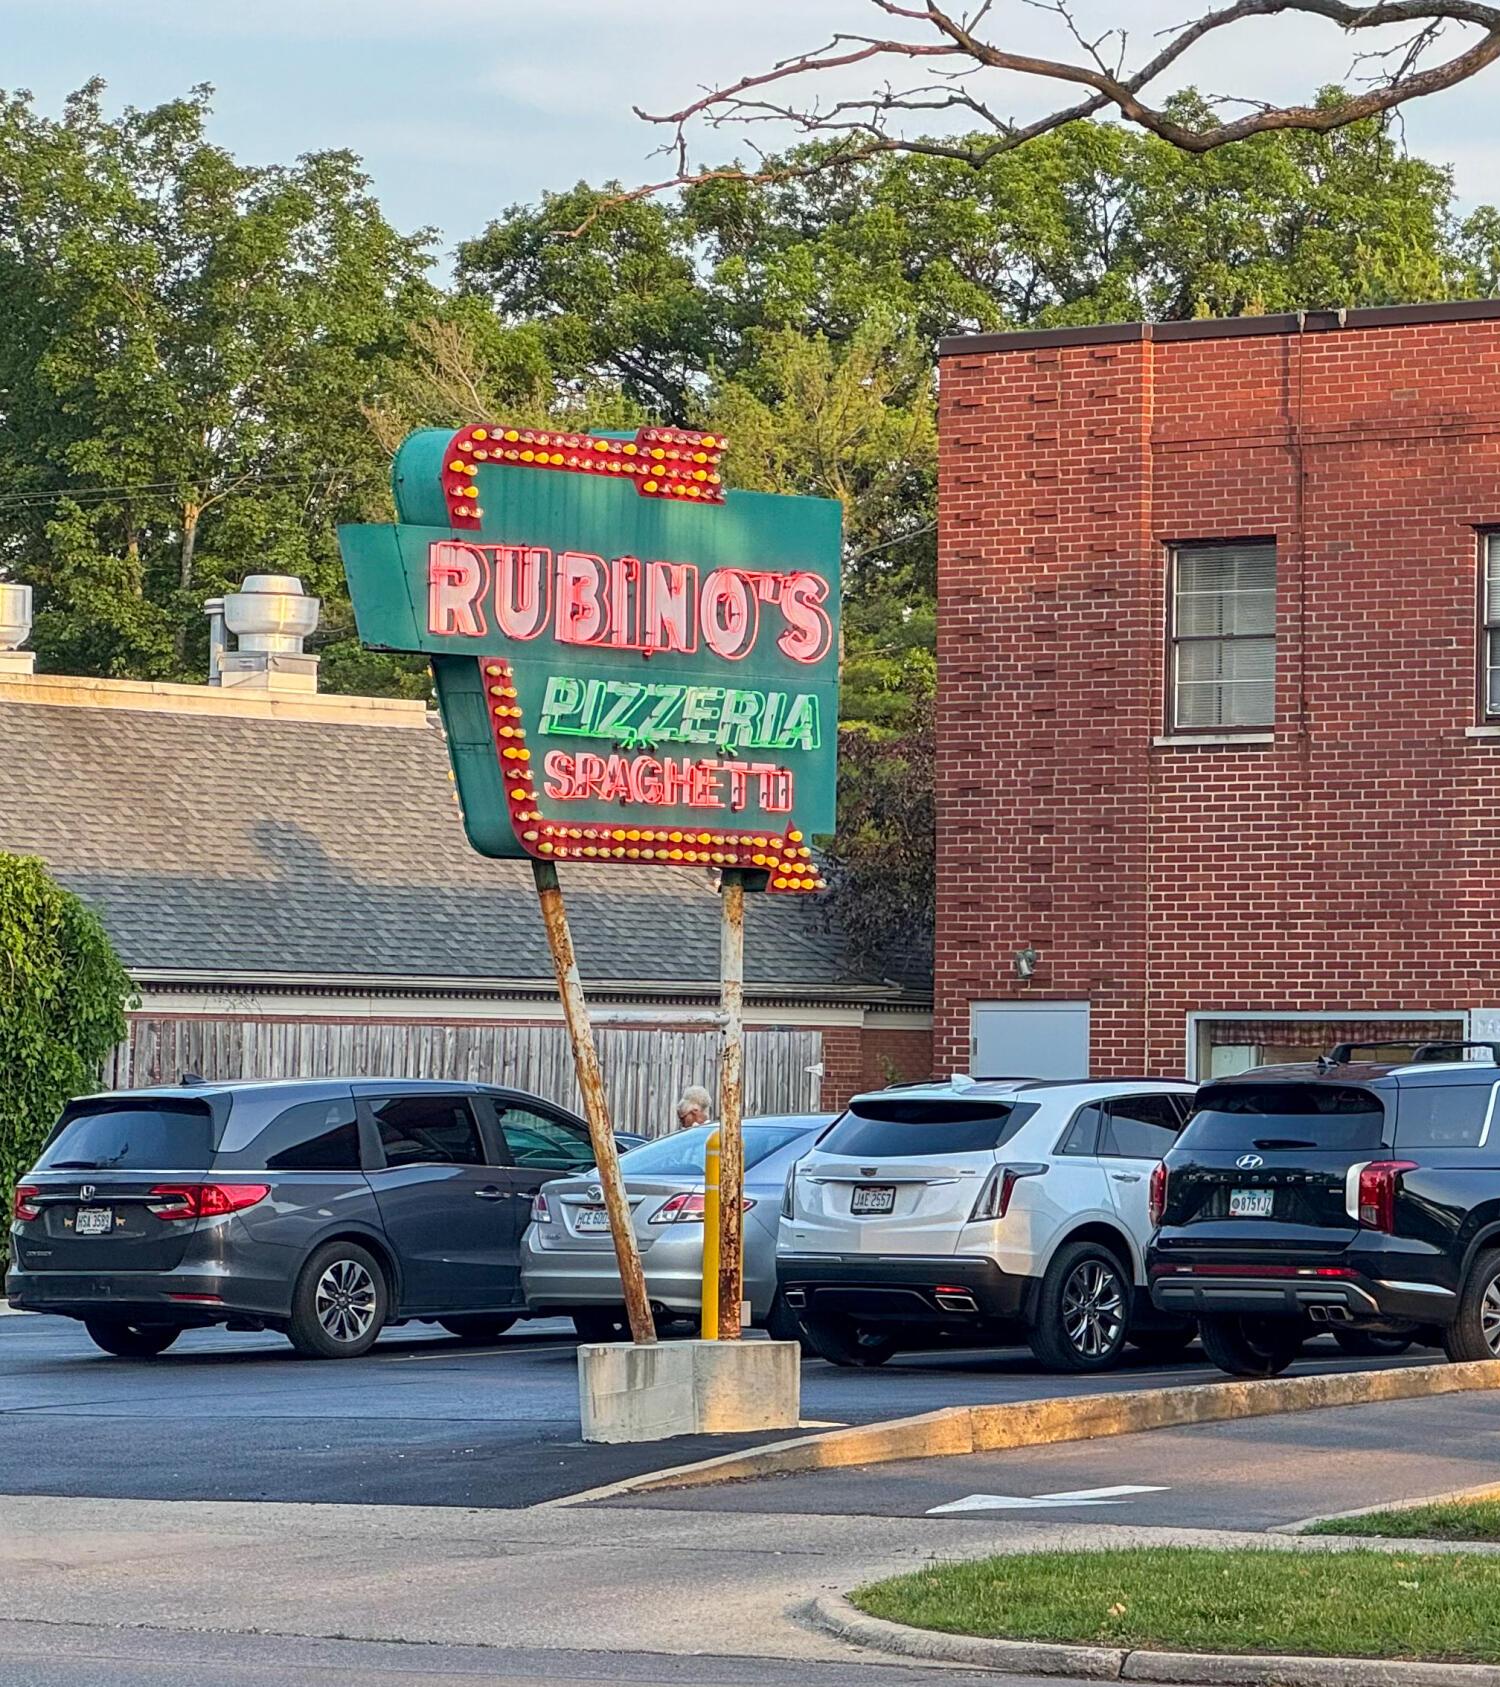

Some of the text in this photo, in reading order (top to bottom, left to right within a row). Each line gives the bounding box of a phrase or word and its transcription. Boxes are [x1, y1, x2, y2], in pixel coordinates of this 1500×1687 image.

[428, 541, 833, 664] RUBINO'S
[538, 676, 821, 751] PIZZERIA
[544, 750, 794, 813] SPAGHETTI
[593, 1212, 609, 1225] 600
[855, 1193, 870, 1207] JAE
